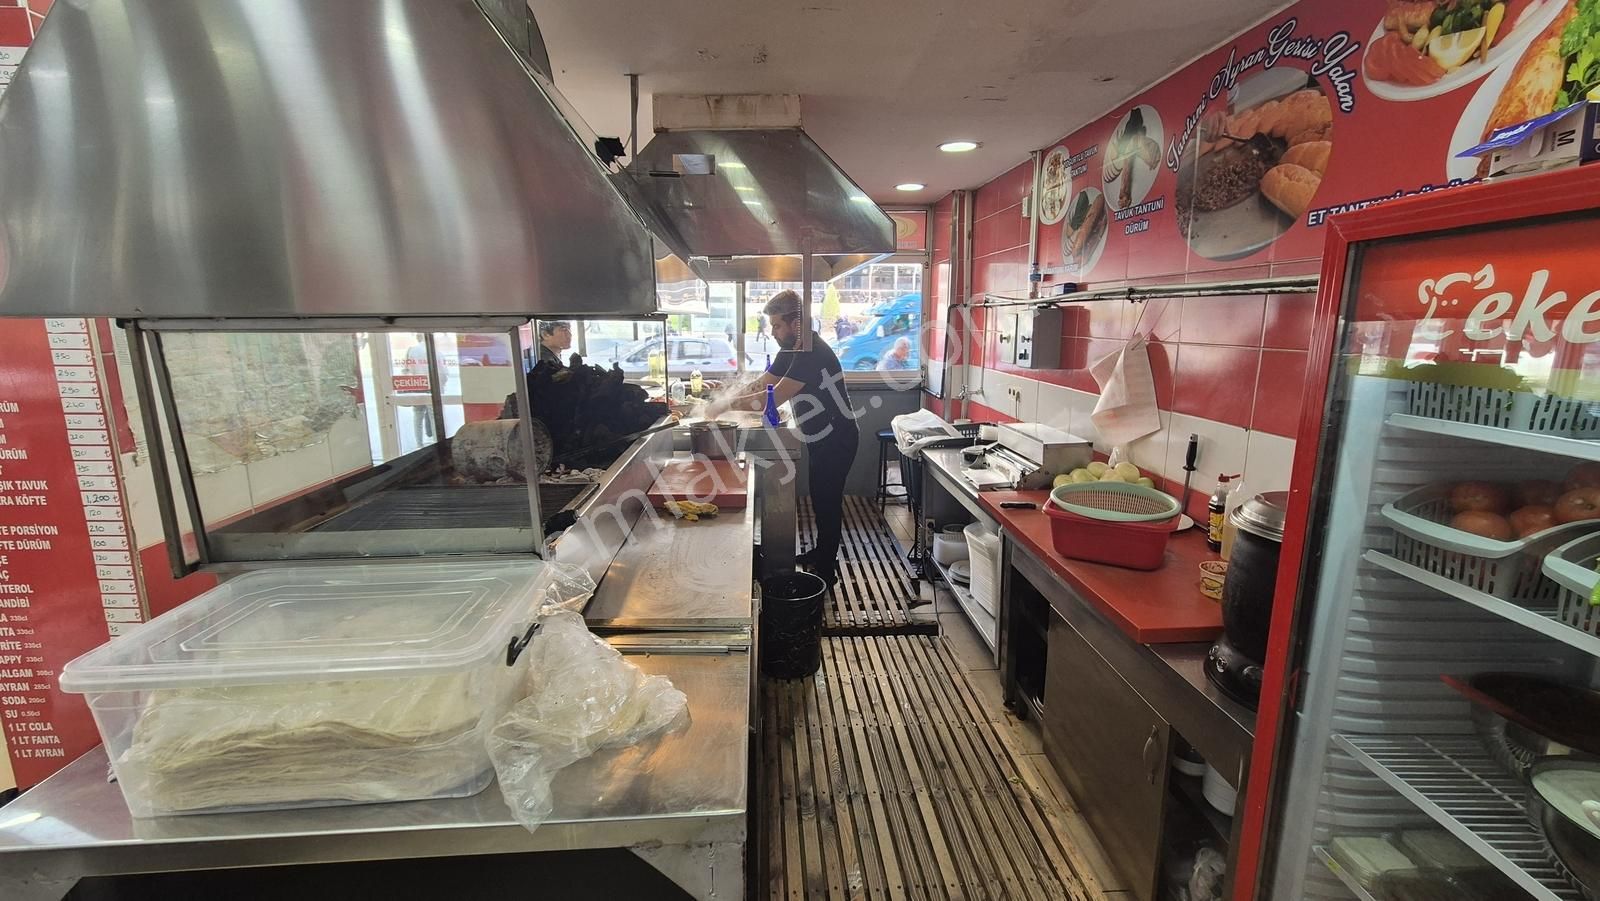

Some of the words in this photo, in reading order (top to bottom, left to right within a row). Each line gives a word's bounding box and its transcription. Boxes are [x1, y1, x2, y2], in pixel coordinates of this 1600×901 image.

[1210, 49, 1266, 99] Ayran
[1311, 32, 1361, 113] Yalan
[1114, 208, 1134, 221] TAVUK
[1135, 197, 1164, 215] TANTUNİ
[1308, 209, 1327, 225] ET
[1125, 219, 1149, 234] DÜRÜM
[393, 377, 429, 389] ÇEKİNİZ
[15, 480, 49, 490] TAVUK
[0, 496, 14, 505] RA
[15, 494, 47, 505] KÖFTE
[10, 523, 58, 535] PORSİYON
[16, 538, 51, 550] DÜRÜM
[0, 682, 30, 691] AYRAN
[2, 696, 27, 705] SODA
[5, 709, 18, 718] SU
[8, 723, 14, 732] 1
[16, 723, 26, 731] LT
[29, 722, 53, 731] COLA
[11, 736, 17, 744] 1
[19, 736, 29, 744] LT
[31, 735, 60, 744] FANTA
[14, 749, 20, 758] 1
[22, 749, 32, 758] LT
[35, 748, 65, 757] AYRAN
